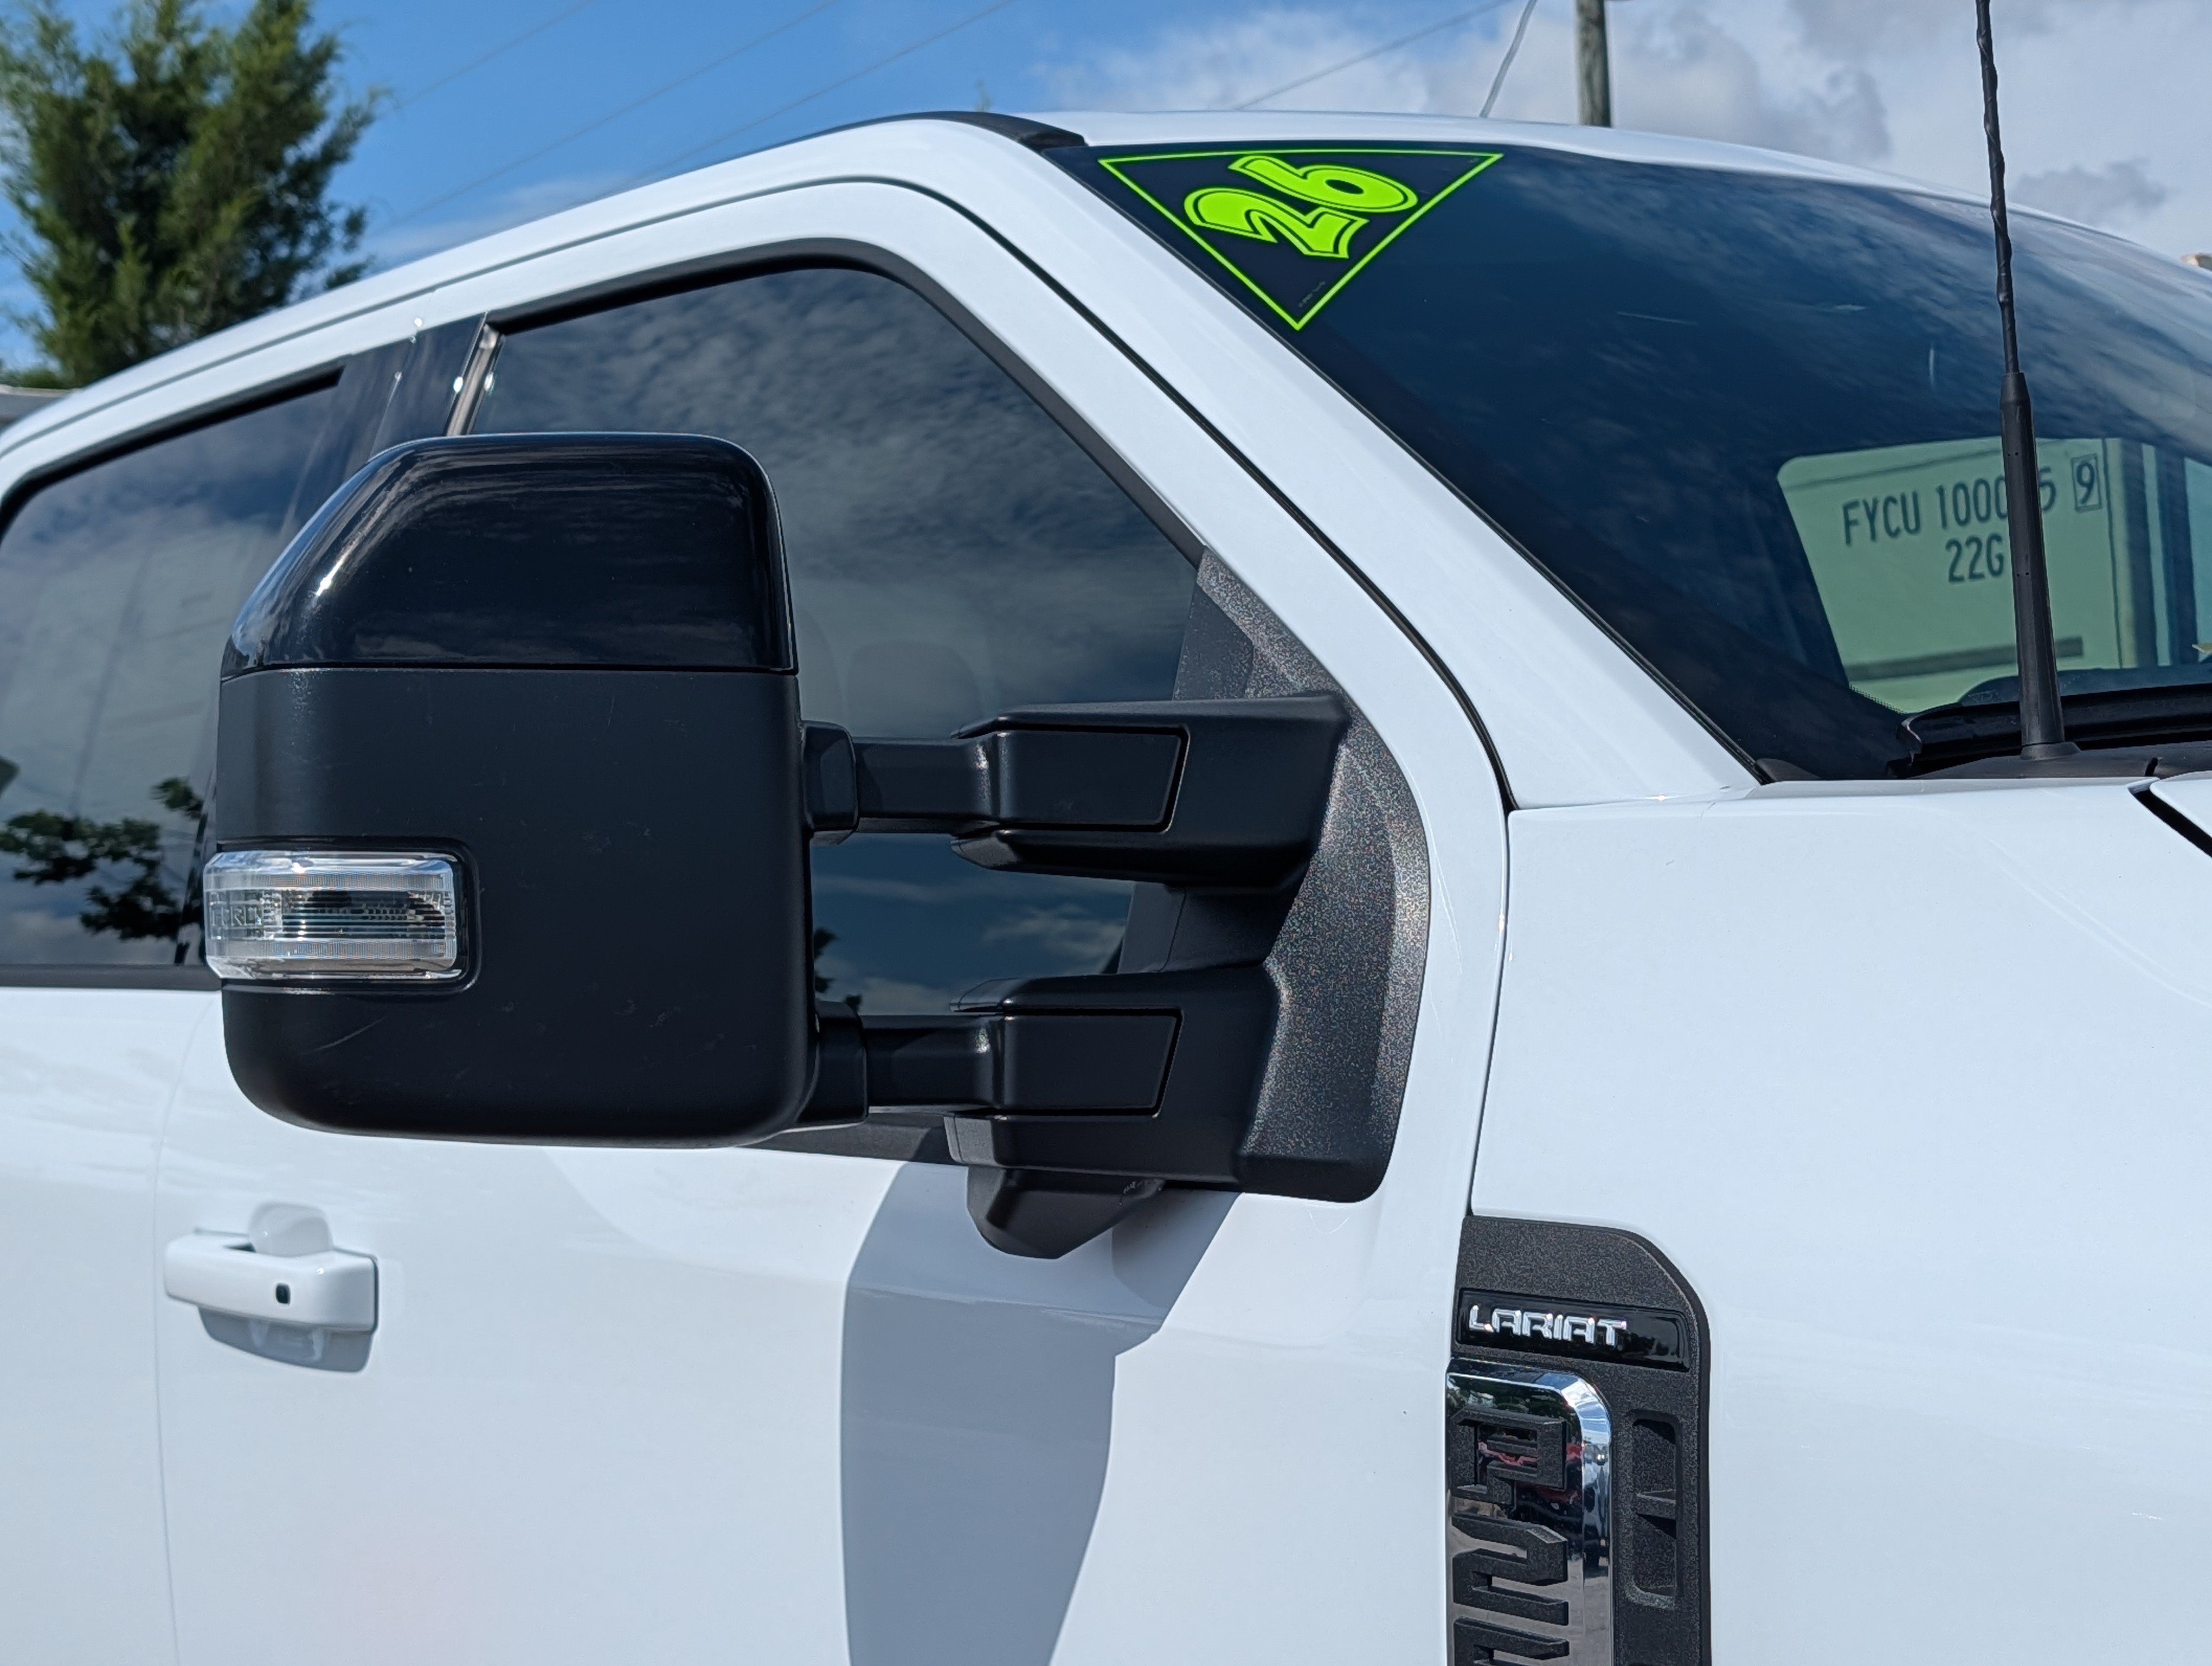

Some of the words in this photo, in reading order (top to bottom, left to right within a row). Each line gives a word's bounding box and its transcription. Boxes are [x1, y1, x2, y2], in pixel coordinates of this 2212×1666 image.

[1184, 155, 1419, 259] 26
[1842, 490, 1921, 546] FYCU
[1936, 466, 2056, 530] 10005
[2076, 461, 2096, 504] 9
[1469, 1304, 1627, 1347] LARIAT
